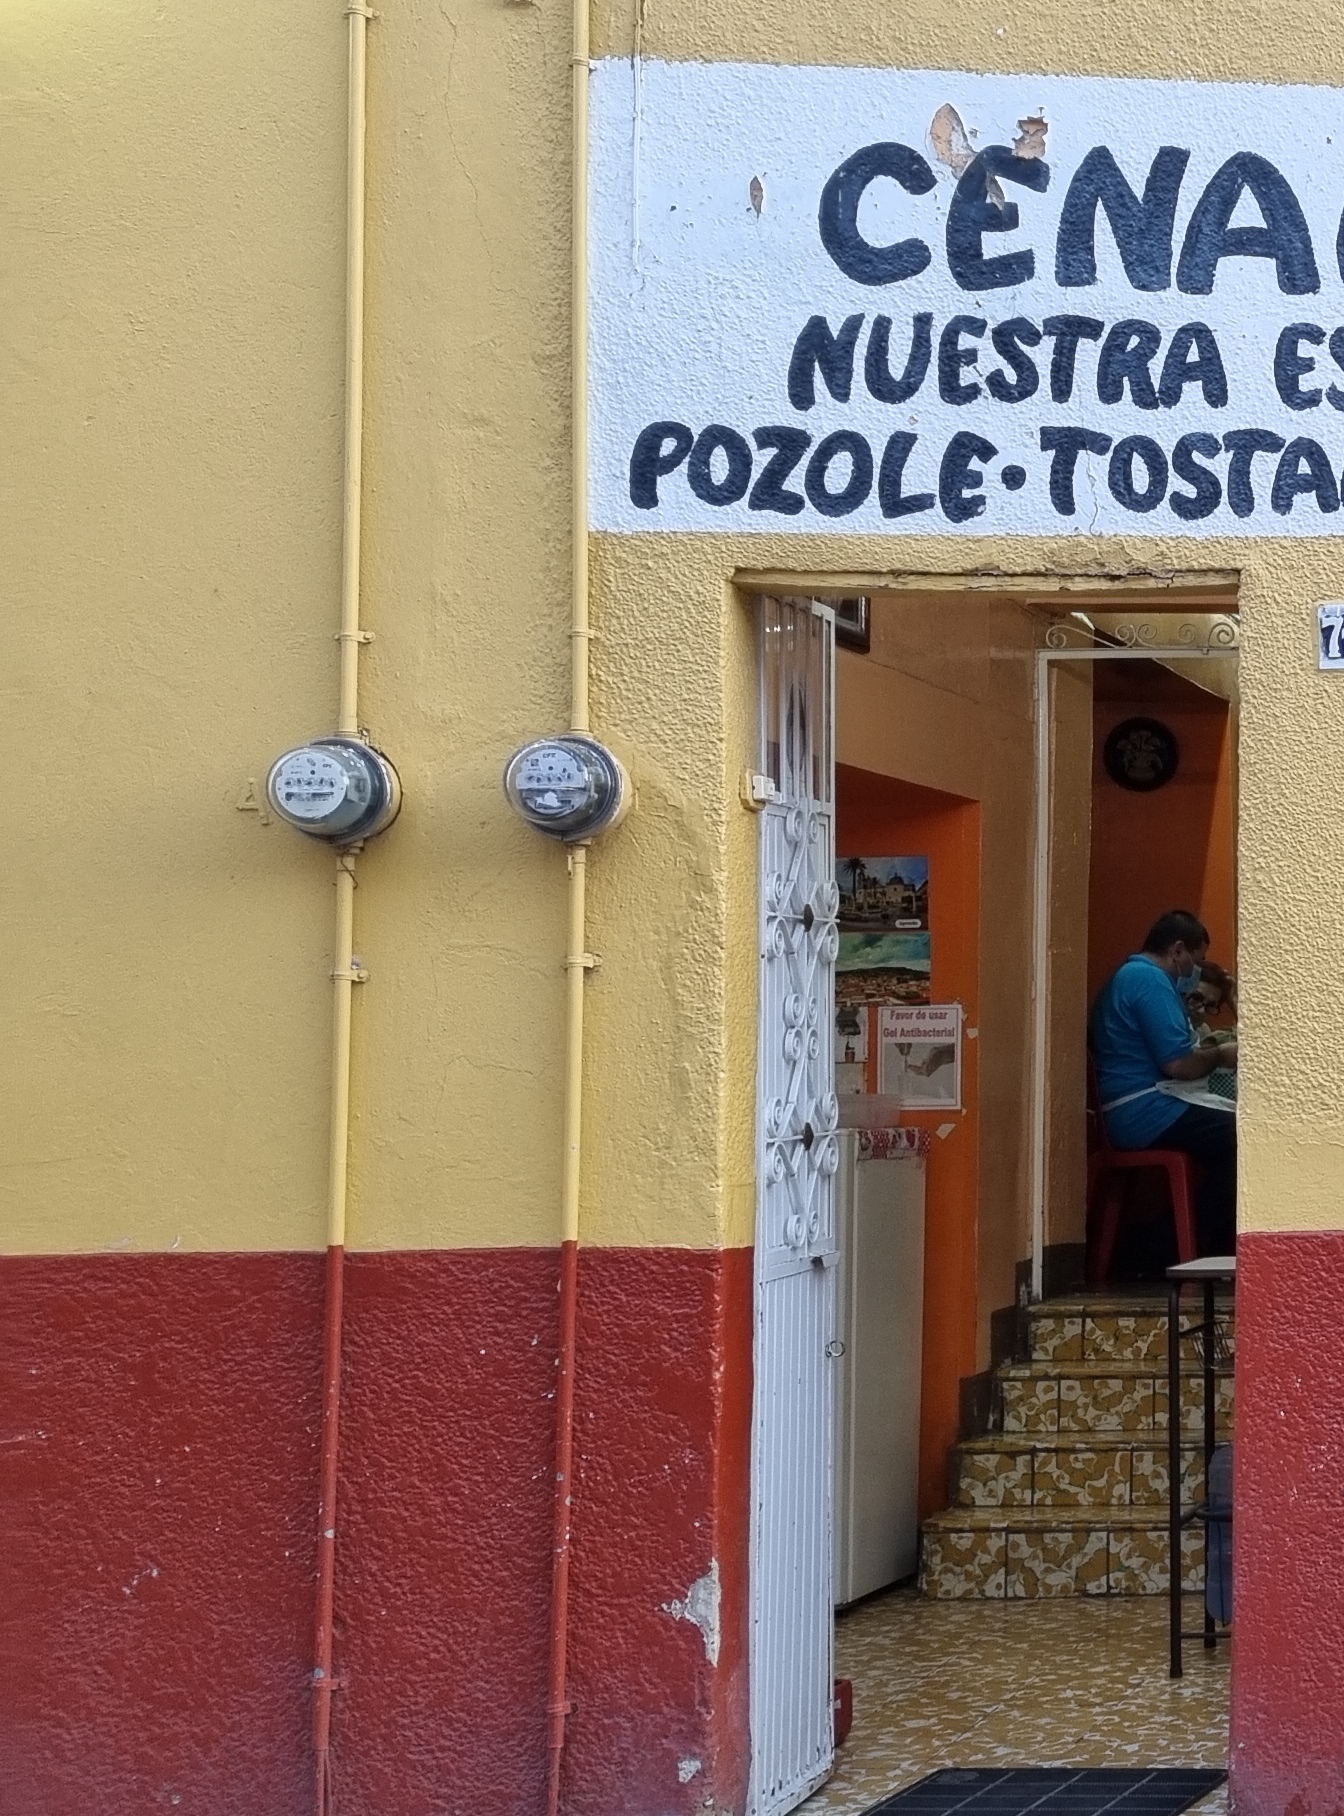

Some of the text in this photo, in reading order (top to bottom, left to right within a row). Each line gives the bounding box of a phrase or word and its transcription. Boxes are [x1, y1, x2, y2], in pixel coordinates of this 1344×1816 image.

[788, 313, 1228, 410] NUESTRA
[890, 1010, 914, 1020] Favor
[928, 1011, 948, 1020] usar
[899, 1027, 955, 1038] Antibacterial
